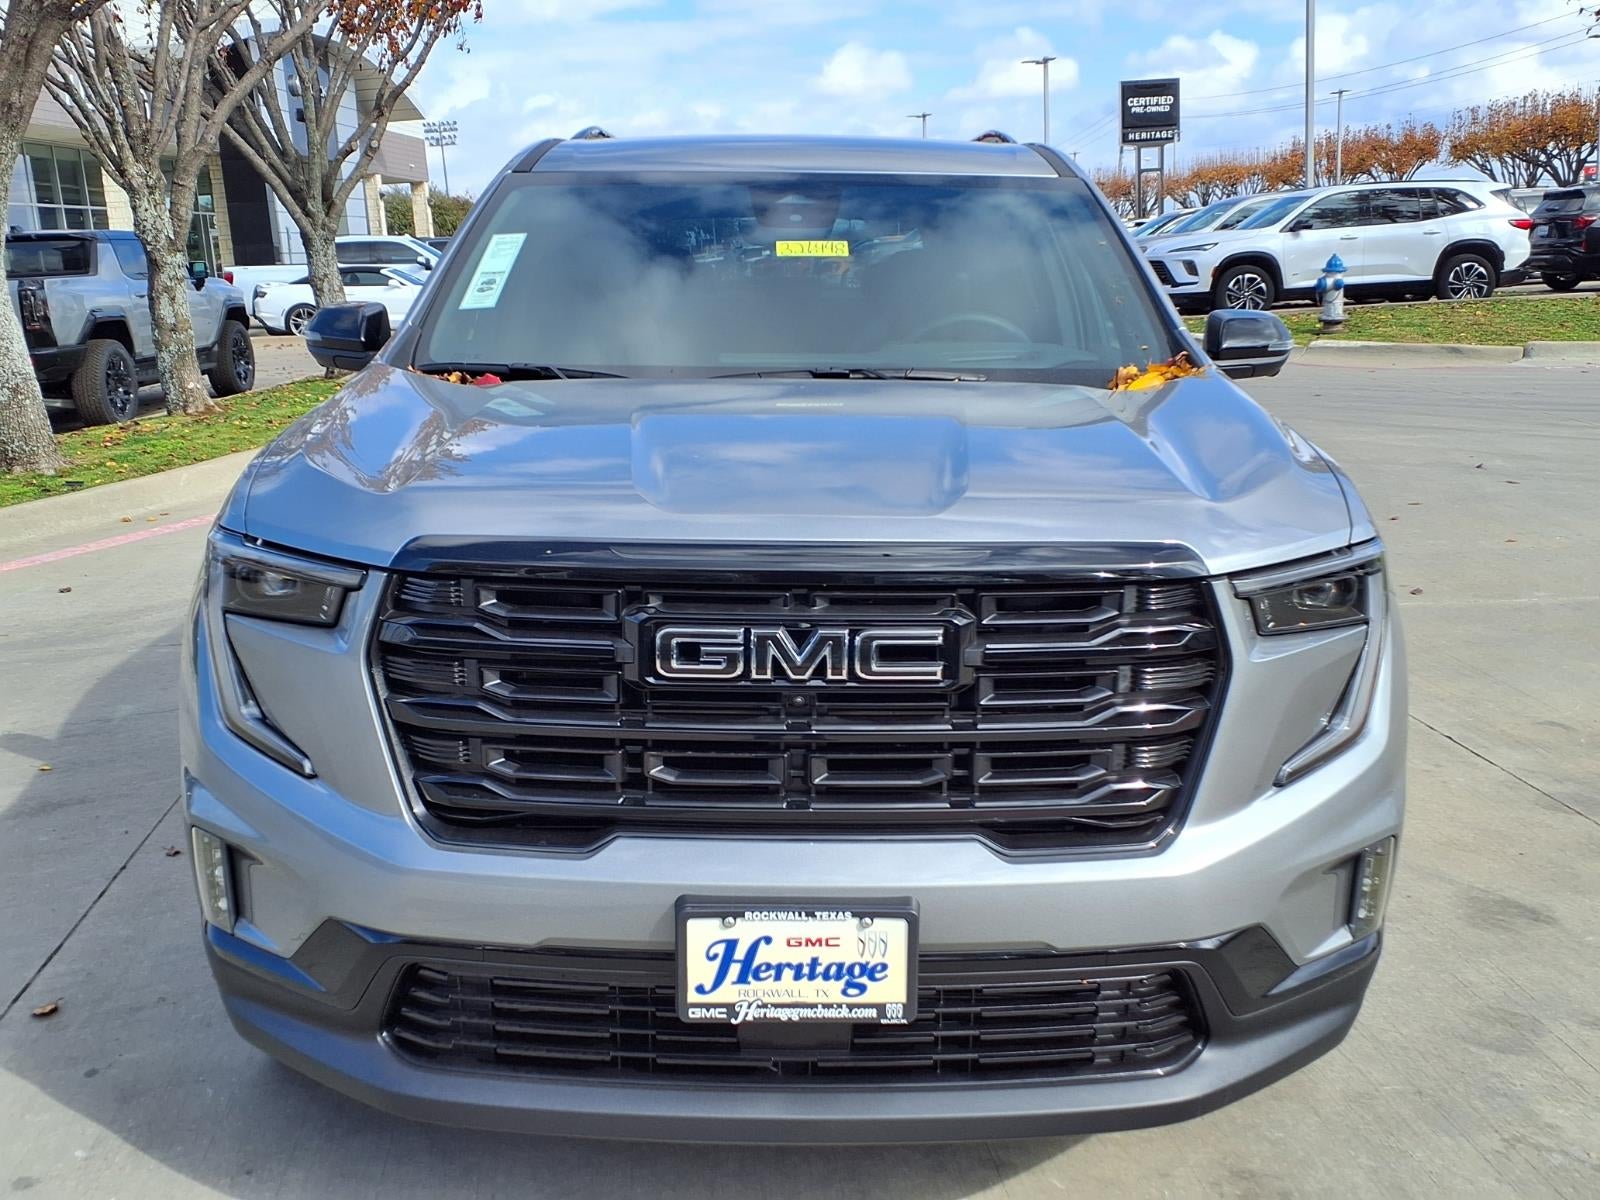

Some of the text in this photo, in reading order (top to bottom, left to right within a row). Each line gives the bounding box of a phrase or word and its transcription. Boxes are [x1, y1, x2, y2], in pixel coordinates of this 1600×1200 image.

[1127, 96, 1174, 106] CERTIFIED
[1131, 105, 1170, 113] PRE-OWNED
[1128, 131, 1173, 140] HERITAGE
[656, 627, 944, 680] GMC
[745, 912, 852, 921] ROCKWALL, TEXAS
[786, 937, 840, 948] GMC
[694, 936, 888, 998] Heritage
[815, 989, 830, 998] TX
[688, 1000, 878, 1024] GMC Heritagegmcbuick.com
